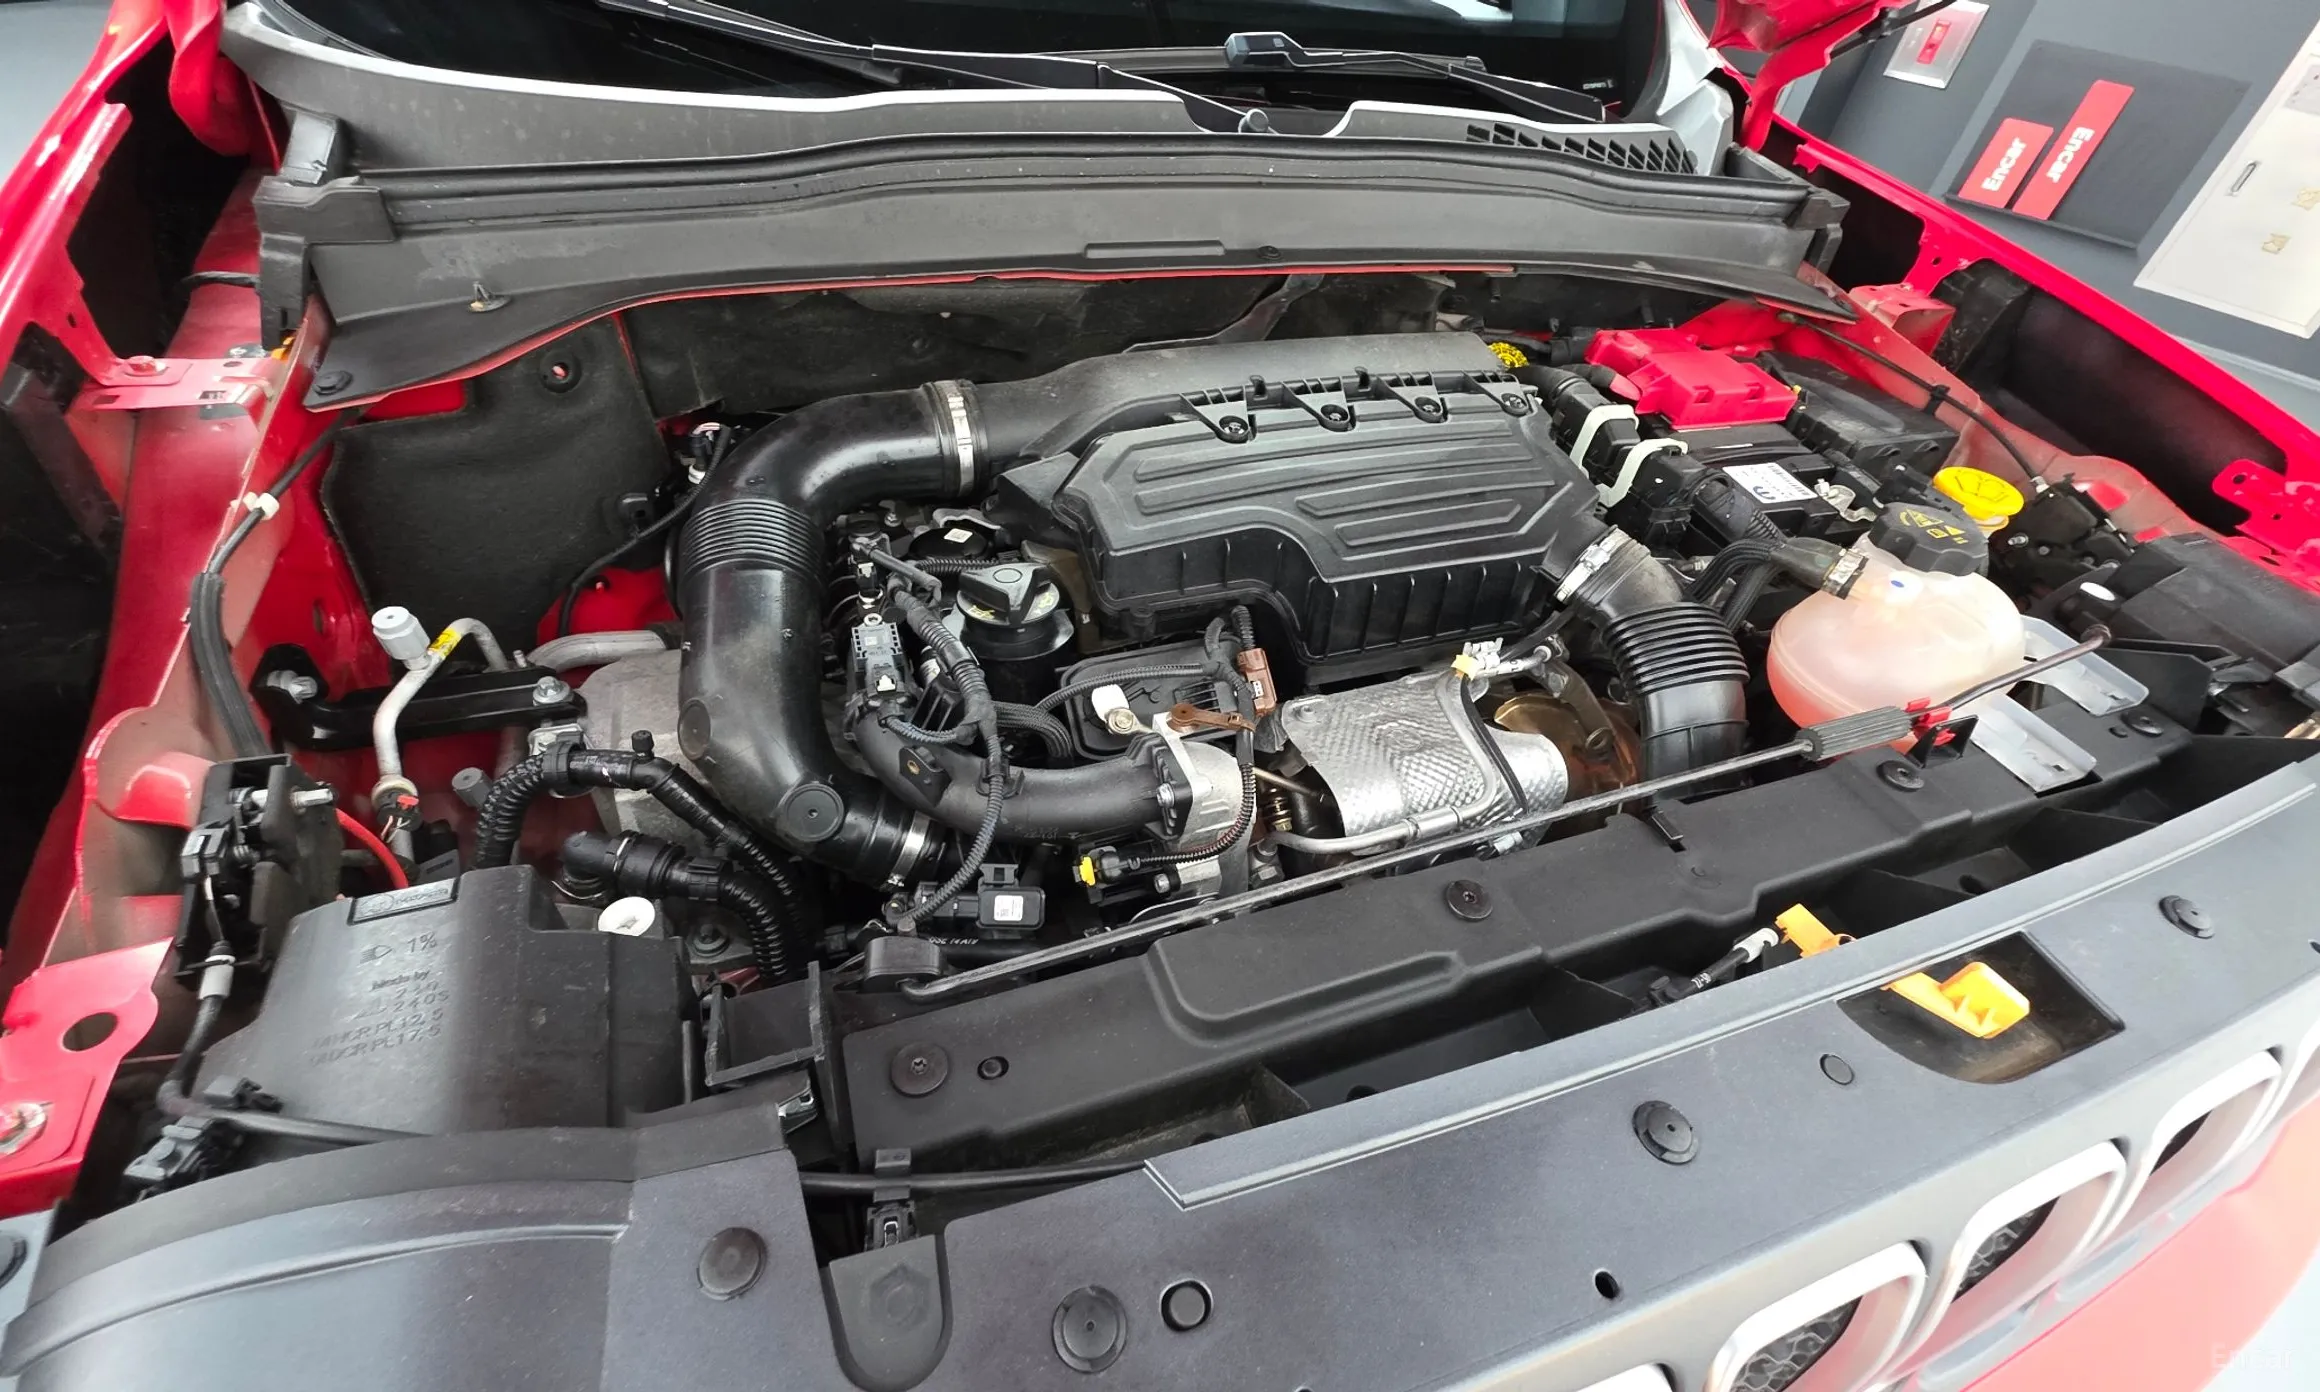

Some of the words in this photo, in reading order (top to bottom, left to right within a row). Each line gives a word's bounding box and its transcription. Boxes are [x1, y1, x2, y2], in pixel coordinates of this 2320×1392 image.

[1981, 137, 2027, 191] Encar
[2046, 127, 2095, 183] Encar
[407, 931, 437, 953] 1%
